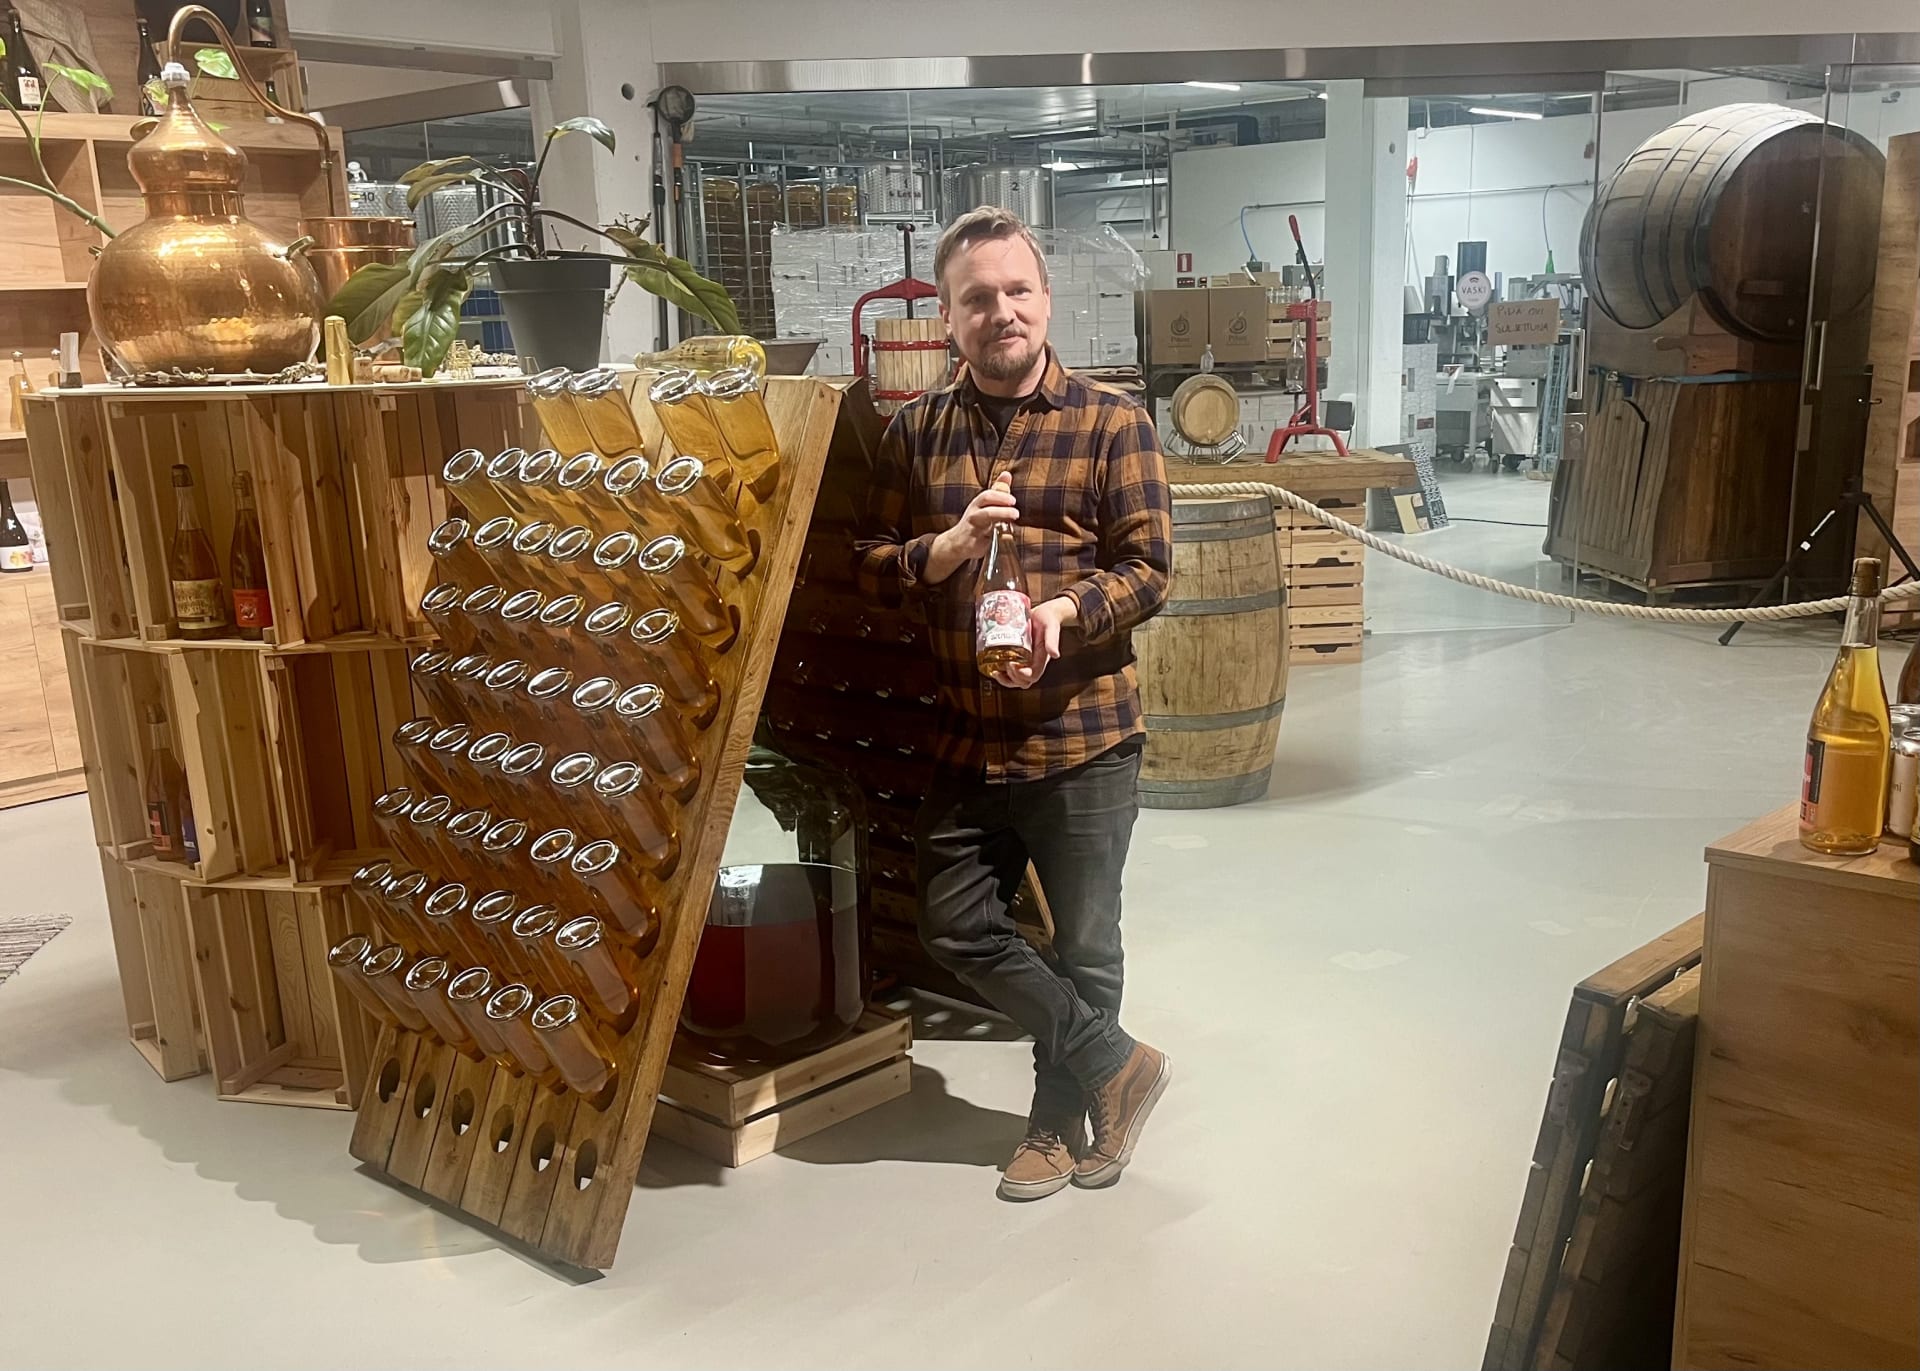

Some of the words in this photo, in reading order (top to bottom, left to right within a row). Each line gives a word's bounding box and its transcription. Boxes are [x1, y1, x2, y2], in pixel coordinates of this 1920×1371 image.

[1011, 181, 1020, 191] 2
[363, 191, 375, 203] 10
[1461, 285, 1487, 295] VASKI
